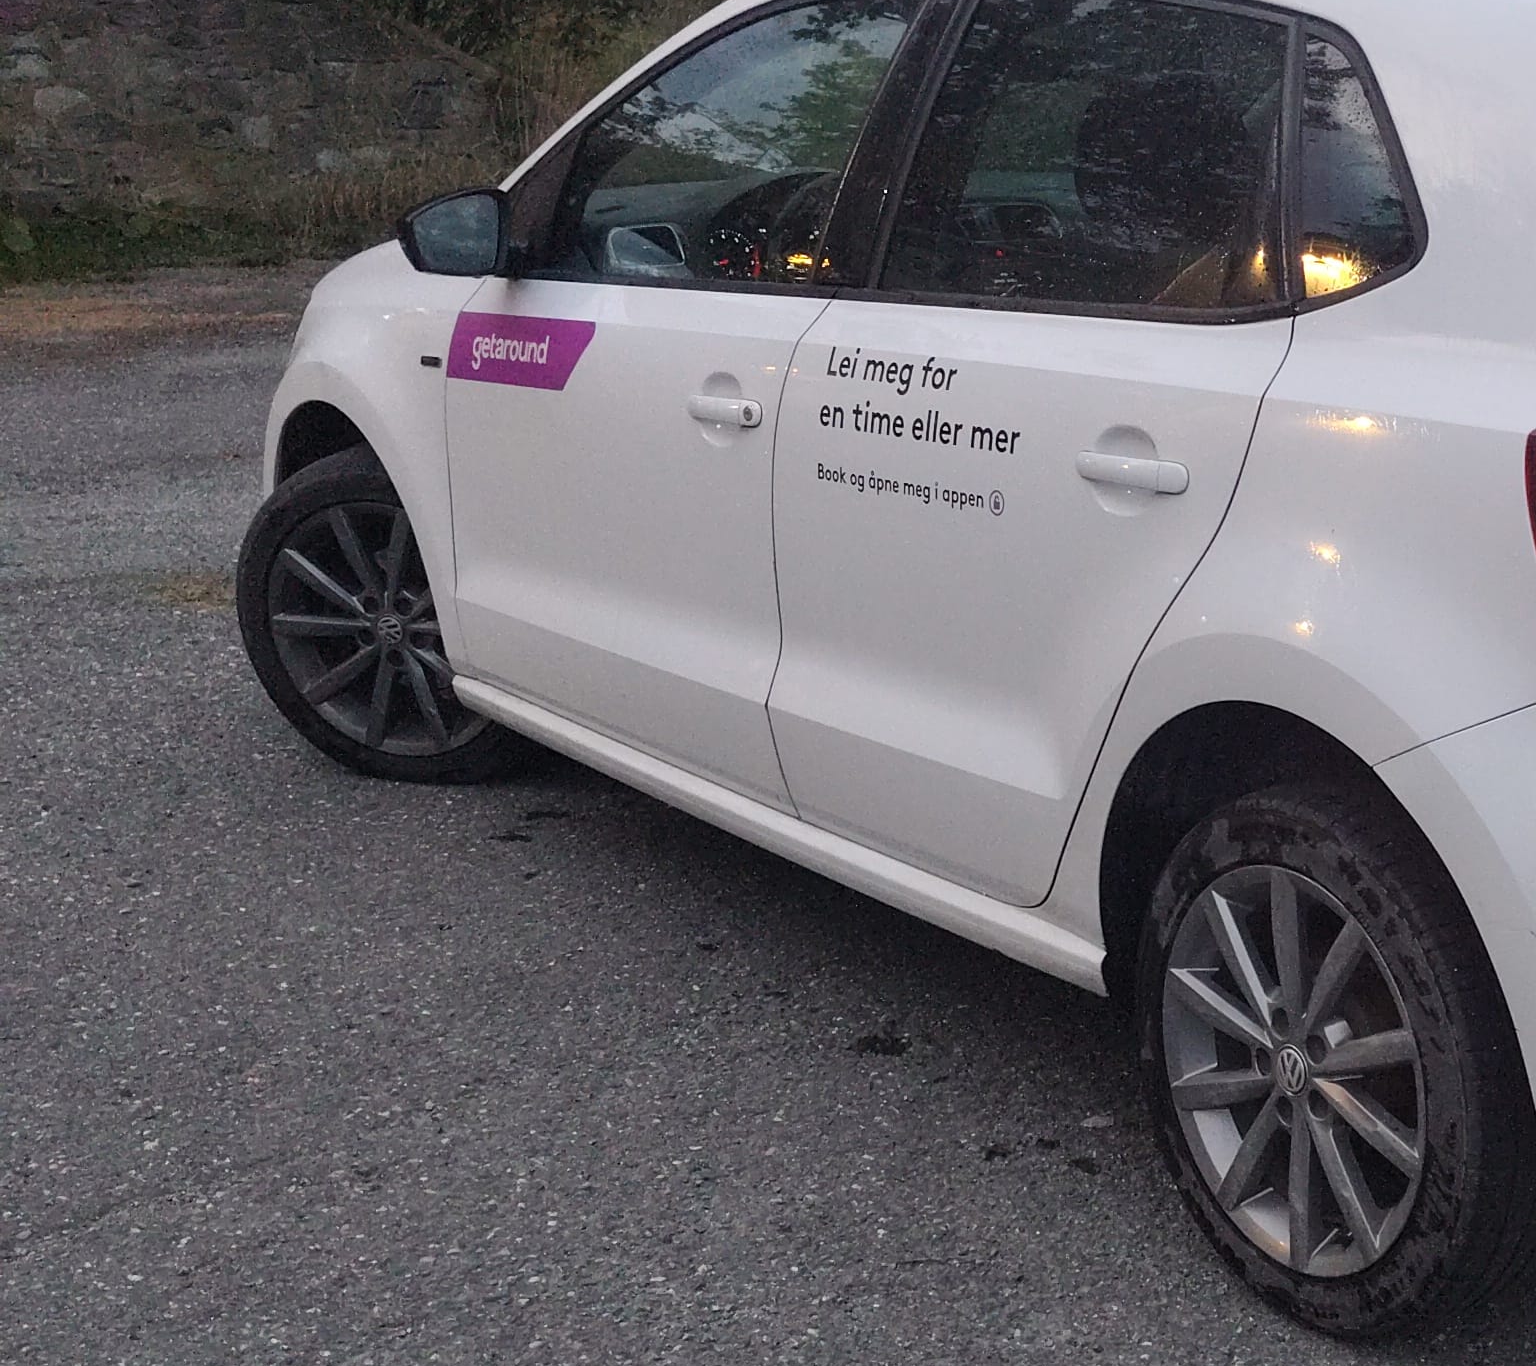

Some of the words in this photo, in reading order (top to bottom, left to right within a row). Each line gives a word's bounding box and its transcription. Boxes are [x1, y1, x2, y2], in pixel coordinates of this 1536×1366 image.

[471, 333, 550, 370] getaround
[827, 346, 861, 379] Lei
[863, 358, 914, 396] meg
[921, 356, 958, 391] for
[819, 404, 844, 429] en
[852, 400, 905, 438] time
[911, 409, 963, 446] eller
[970, 425, 1021, 455] mer
[817, 462, 847, 484] Book
[849, 471, 865, 493] og
[868, 470, 900, 496] åpne
[903, 482, 931, 504] meg
[934, 481, 939, 500] i
[942, 487, 984, 511] appen
